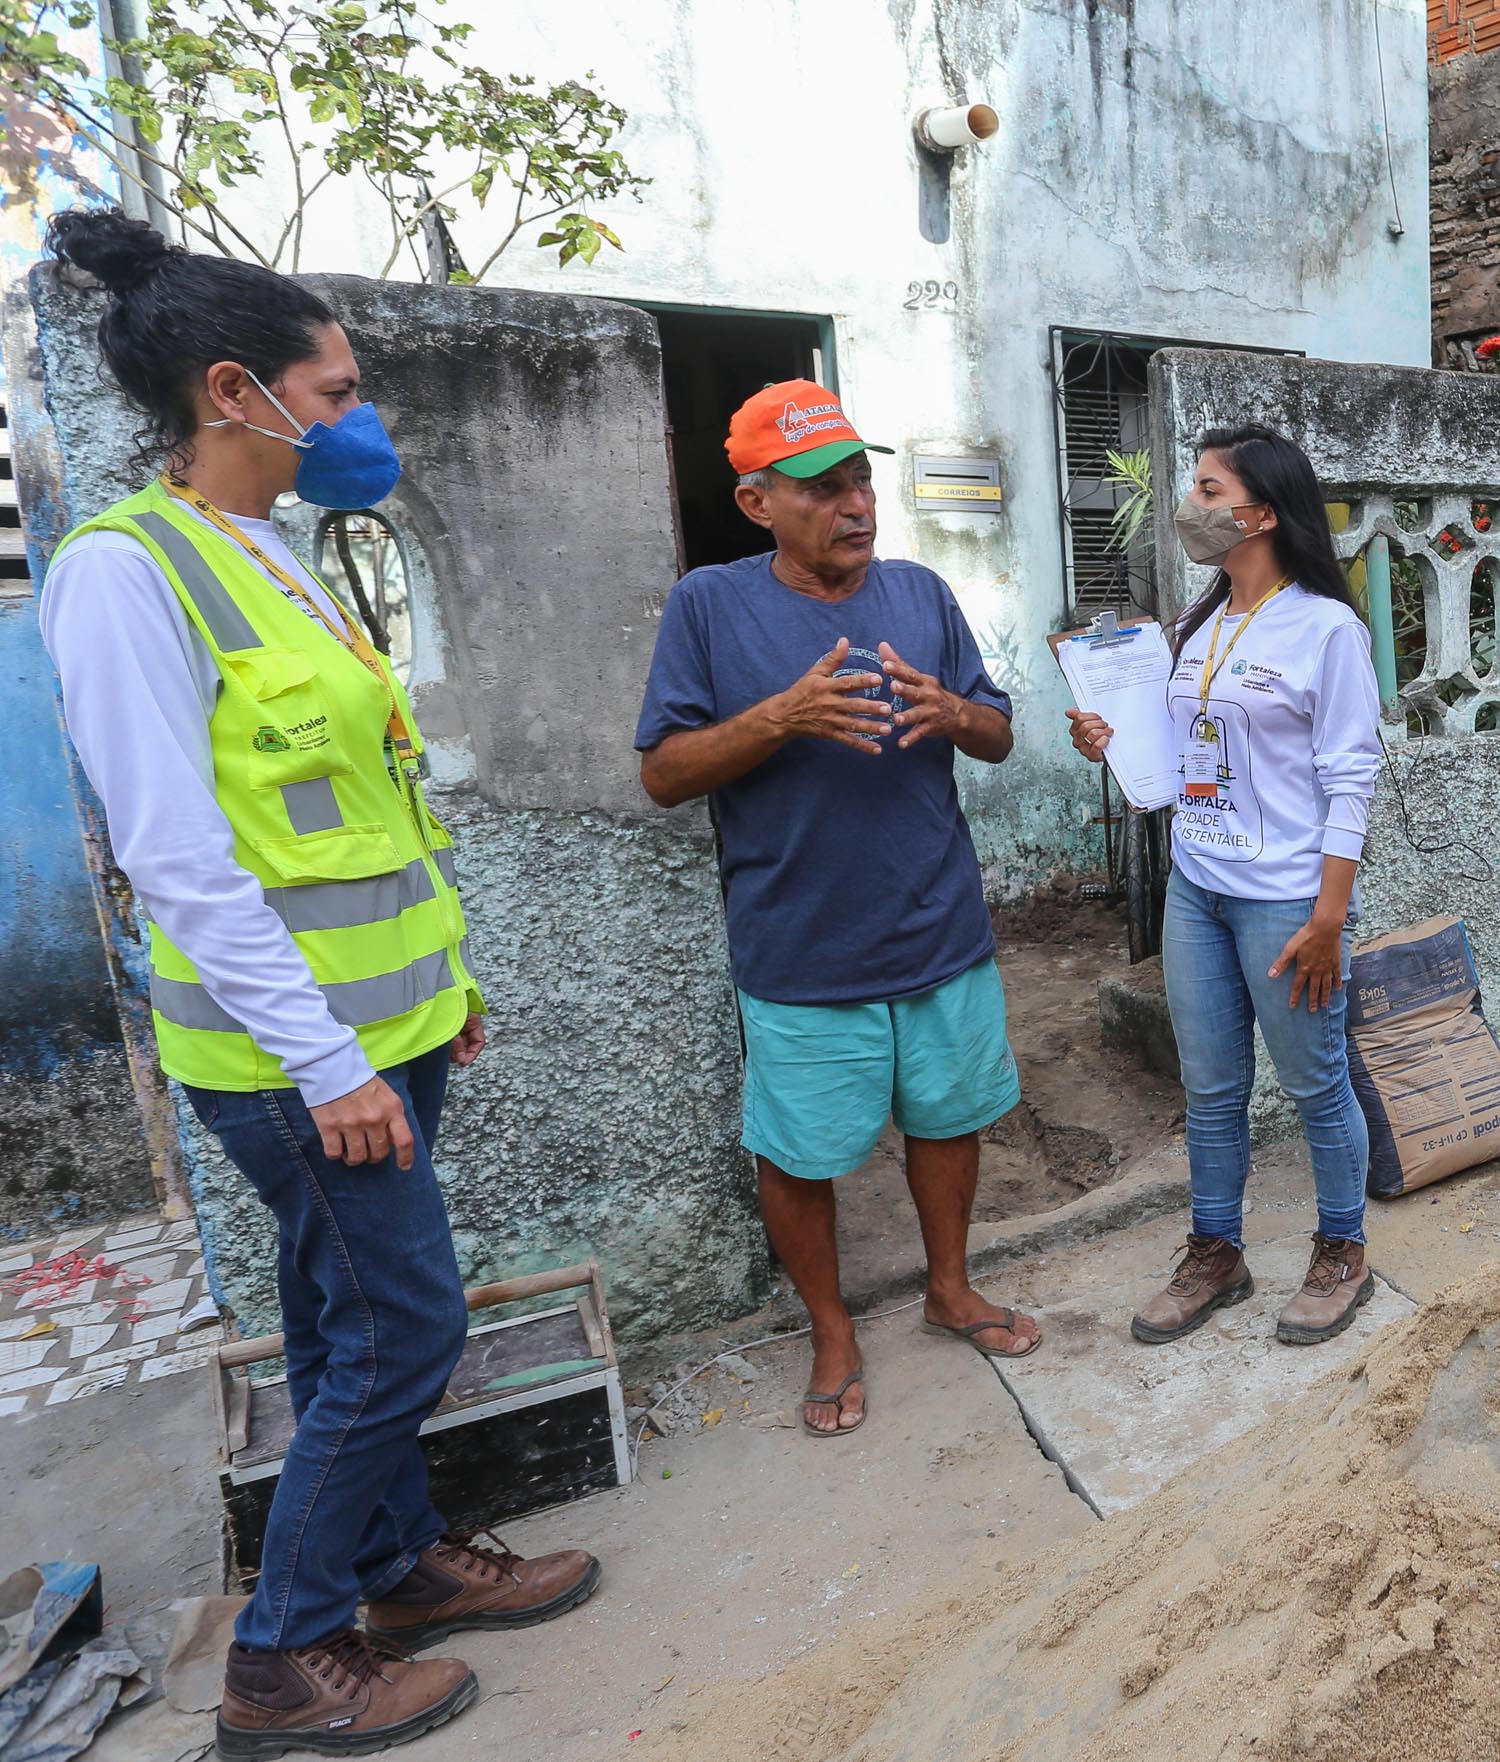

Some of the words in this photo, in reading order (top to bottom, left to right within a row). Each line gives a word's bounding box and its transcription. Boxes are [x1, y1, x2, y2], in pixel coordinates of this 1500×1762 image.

[806, 424, 815, 434] de
[938, 488, 981, 497] CORREIOS
[1248, 664, 1283, 678] Fortaleza
[1179, 810, 1220, 827] CIDADE
[1358, 985, 1387, 1001] 50kg
[1456, 1129, 1468, 1141] CP
